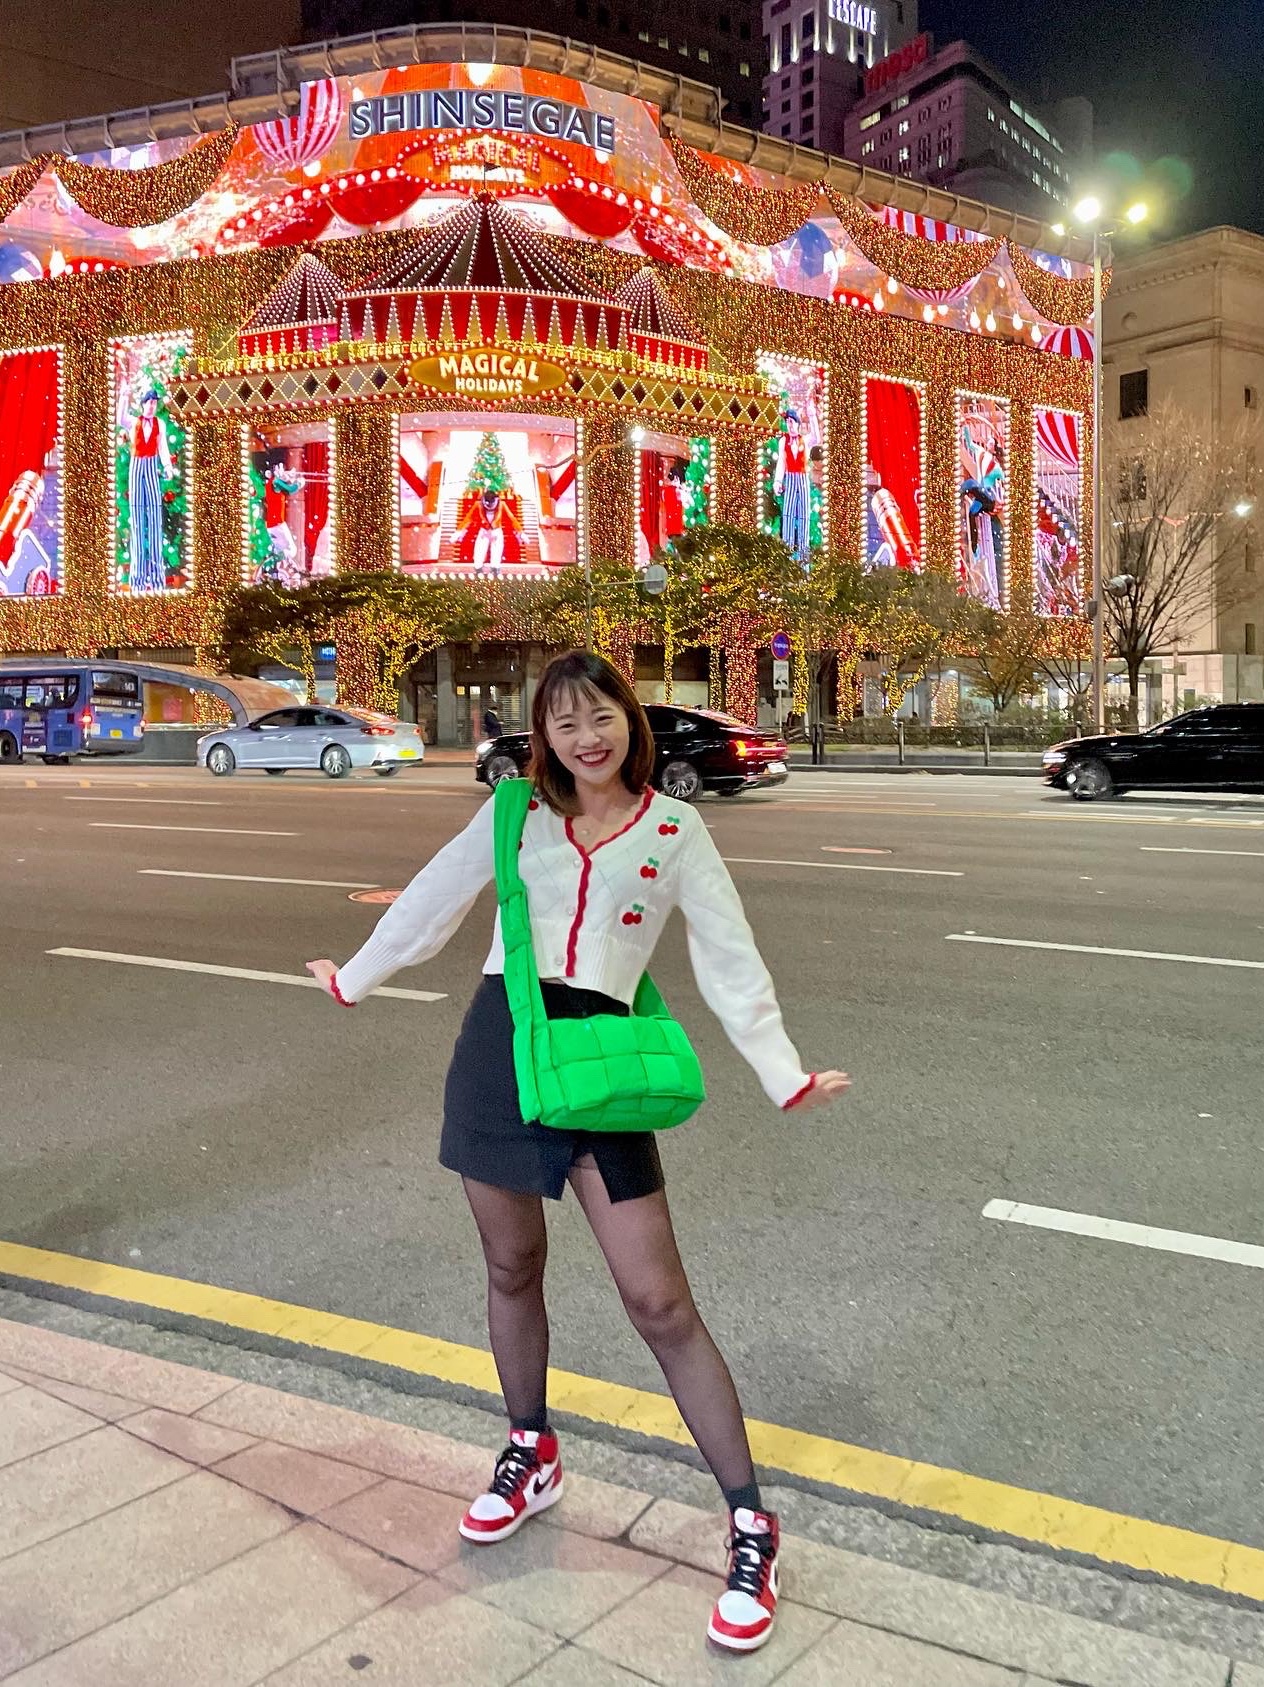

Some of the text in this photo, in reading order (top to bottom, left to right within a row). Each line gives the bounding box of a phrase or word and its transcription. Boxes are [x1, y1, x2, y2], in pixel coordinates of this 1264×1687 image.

[351, 92, 614, 152] SHINSEGAE
[433, 141, 541, 174] MAGICAL
[438, 354, 540, 383] MAGICAL
[455, 377, 523, 393] HOLIDAYS
